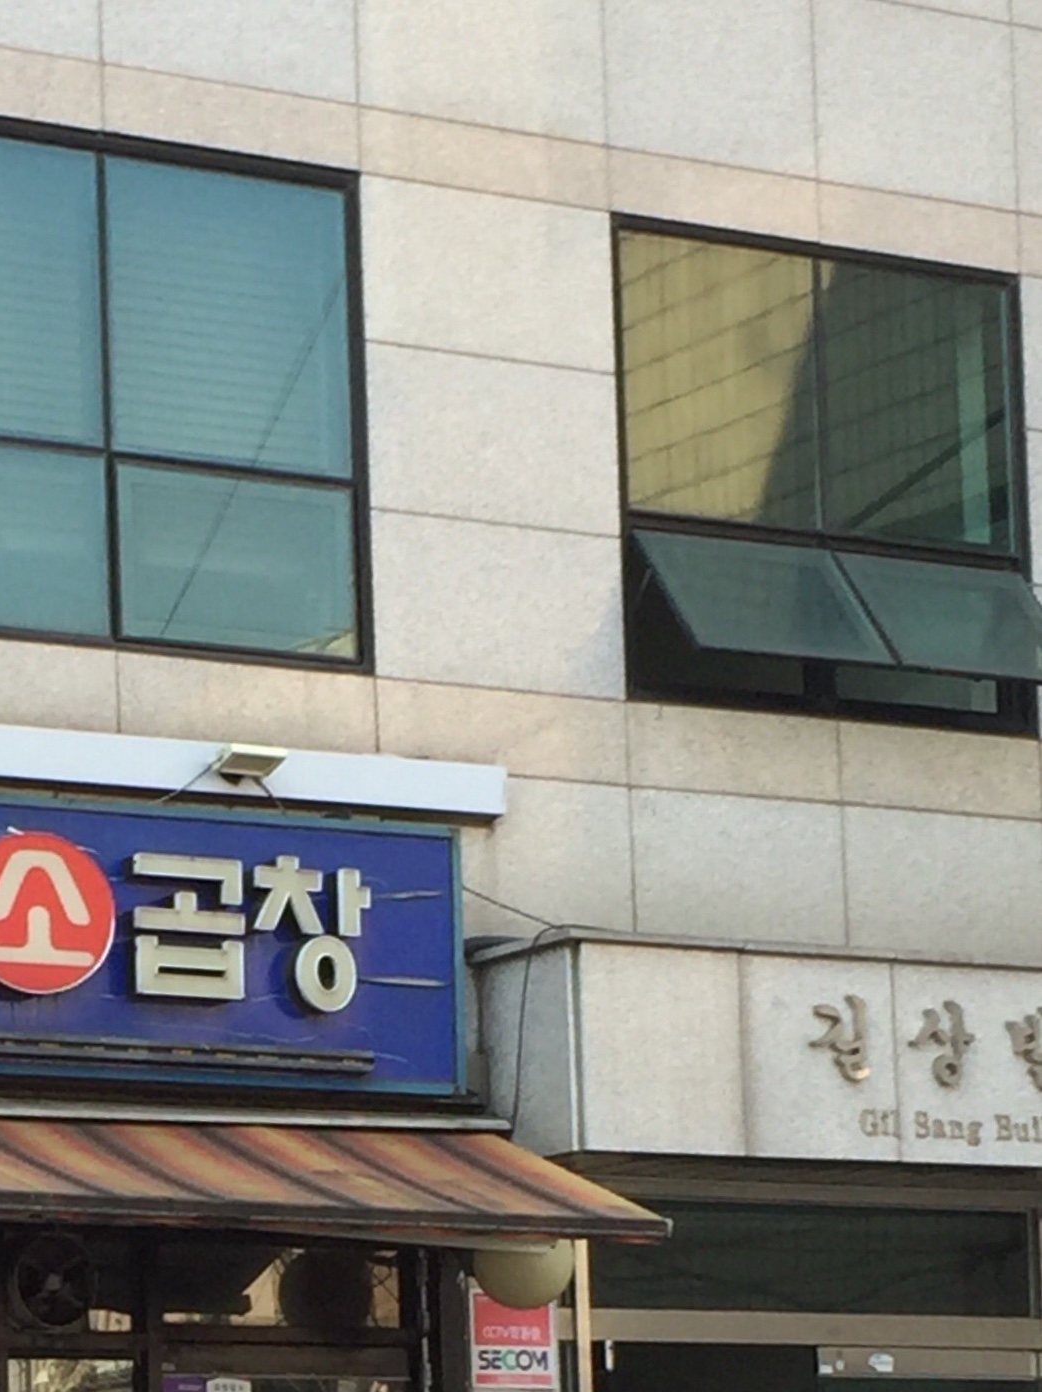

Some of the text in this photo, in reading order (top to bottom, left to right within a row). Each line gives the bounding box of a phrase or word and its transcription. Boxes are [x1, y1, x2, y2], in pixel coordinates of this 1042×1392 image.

[131, 852, 371, 1013] 곱창
[913, 1110, 984, 1148] Sang
[478, 1349, 549, 1371] SECOM
